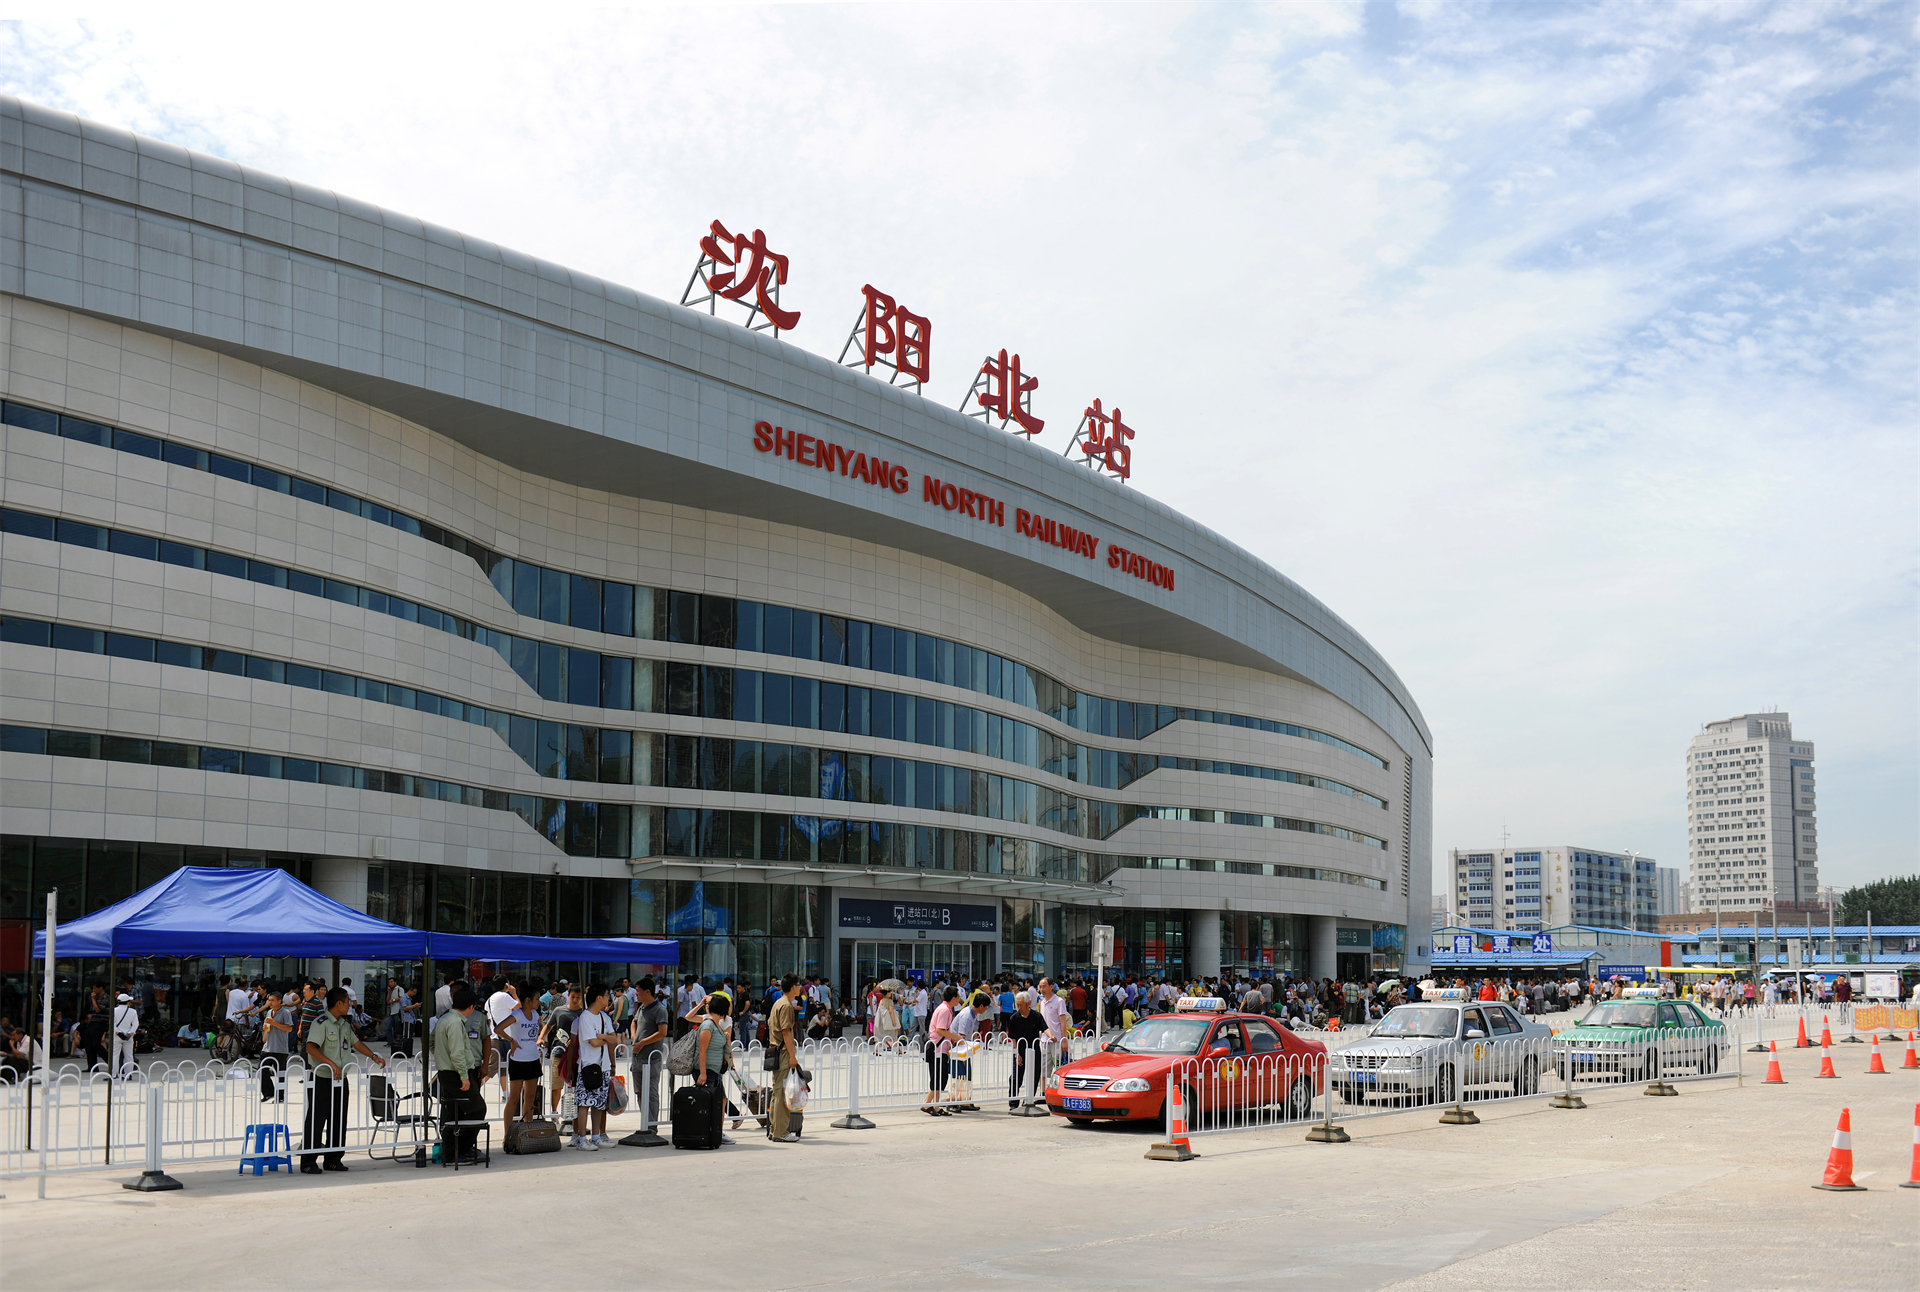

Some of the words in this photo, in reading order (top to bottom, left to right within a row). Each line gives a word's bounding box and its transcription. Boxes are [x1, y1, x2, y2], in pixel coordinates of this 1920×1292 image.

[700, 219, 1135, 479] 沈阳北站
[754, 420, 908, 495] SHENYANG
[924, 475, 1005, 527] NORTH
[1016, 508, 1100, 560] RAILWAY
[1108, 544, 1175, 592] STATION
[942, 908, 951, 925] B
[1455, 936, 1550, 953] 售票处
